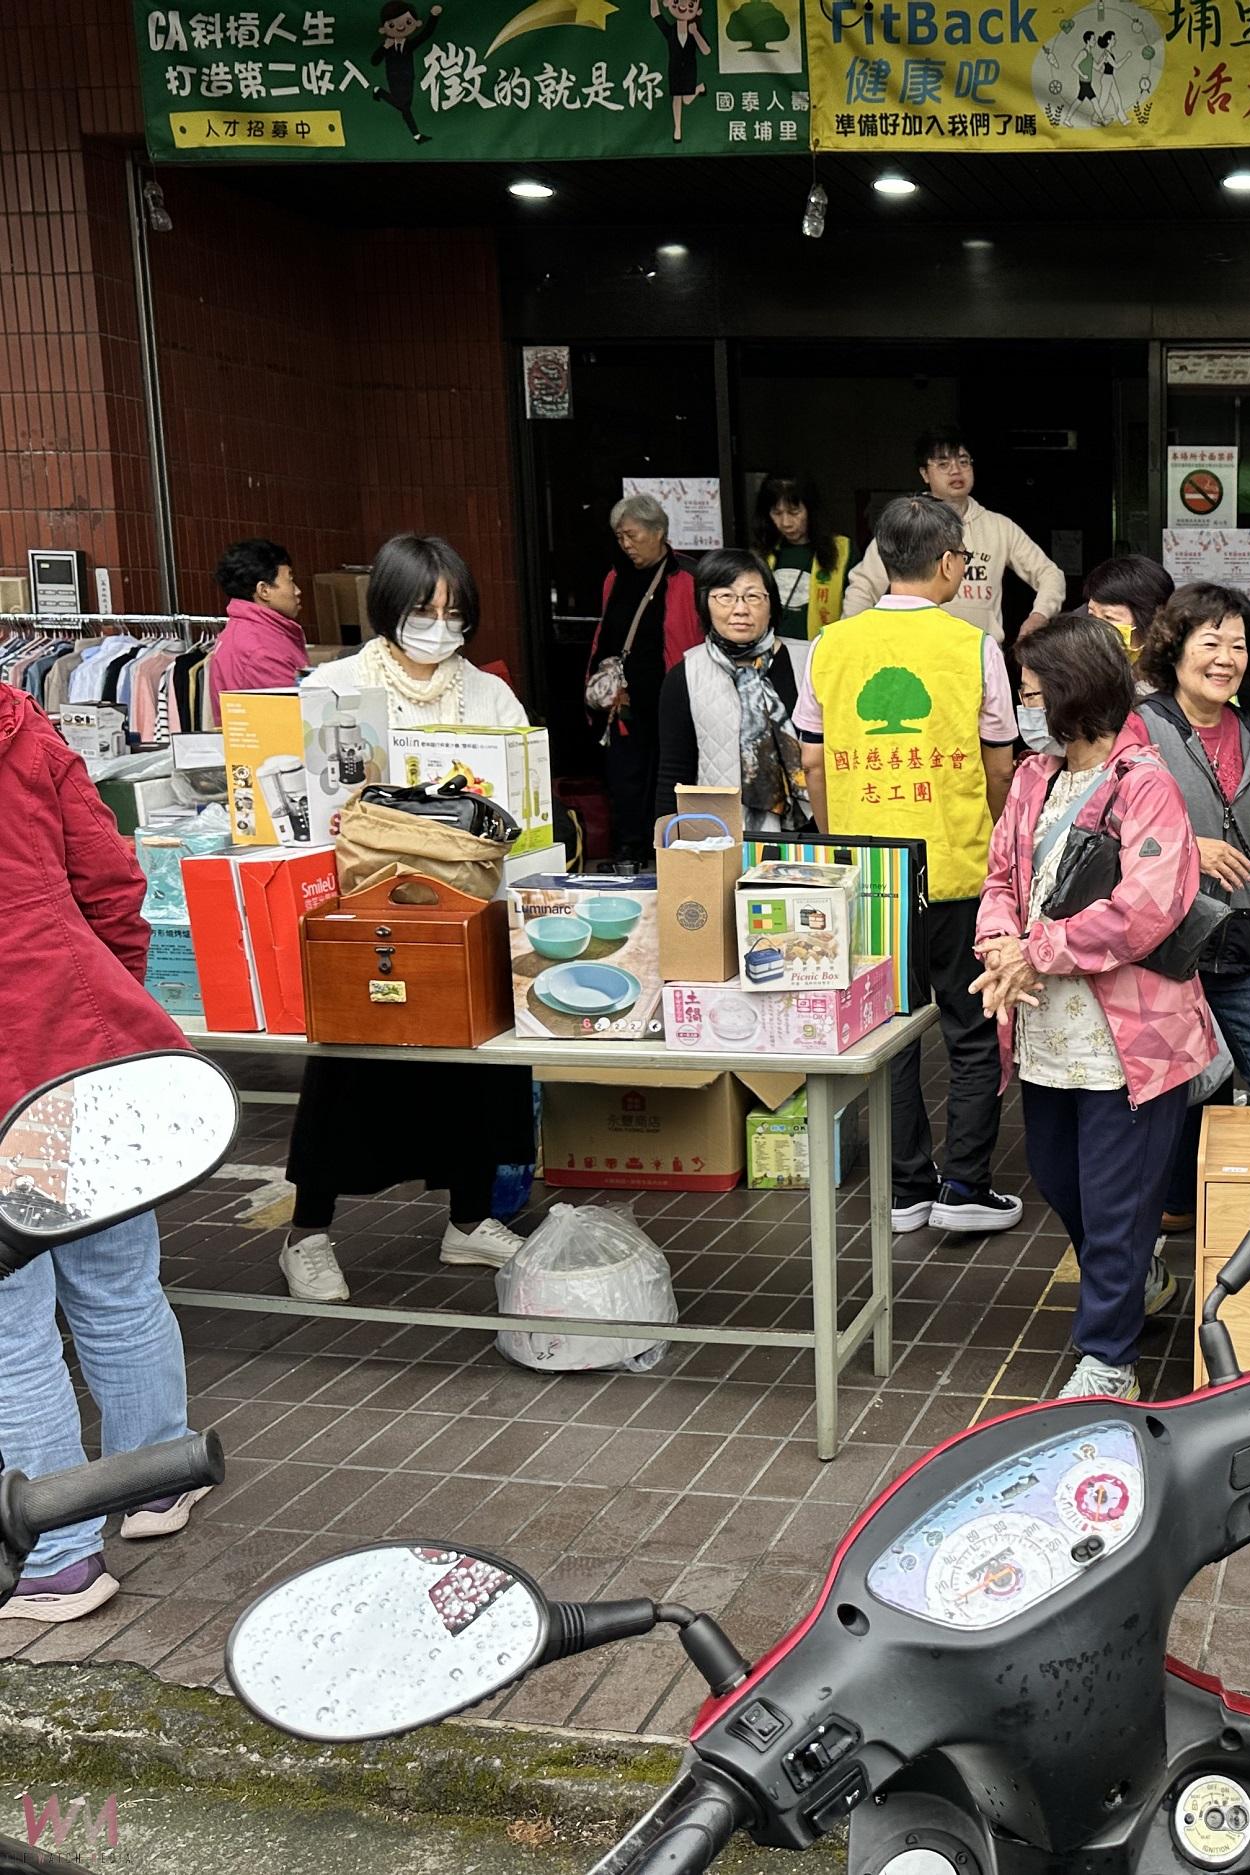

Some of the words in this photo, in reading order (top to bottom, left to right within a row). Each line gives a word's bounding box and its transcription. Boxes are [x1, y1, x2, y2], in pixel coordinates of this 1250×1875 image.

[147, 9, 336, 52] CA斜槓人生
[831, 0, 1039, 46] FitBack
[165, 59, 370, 98] 打造第二收入
[420, 42, 664, 111] 徵的就是你
[845, 55, 1001, 107] 健康吧
[715, 92, 811, 113] 國泰人壽
[204, 118, 312, 140] 人才招募中
[727, 121, 799, 142] 展埔里
[835, 111, 1038, 138] 準備好加入我們了嗎
[957, 585, 993, 600] RIS
[393, 736, 419, 748] kolin
[861, 781, 932, 803] 志工團
[514, 902, 572, 915] Luminarc
[791, 971, 819, 981] Picnic
[822, 971, 839, 981] Box
[583, 1018, 592, 1029] 6
[1202, 1844, 1230, 1854] IGNITION
